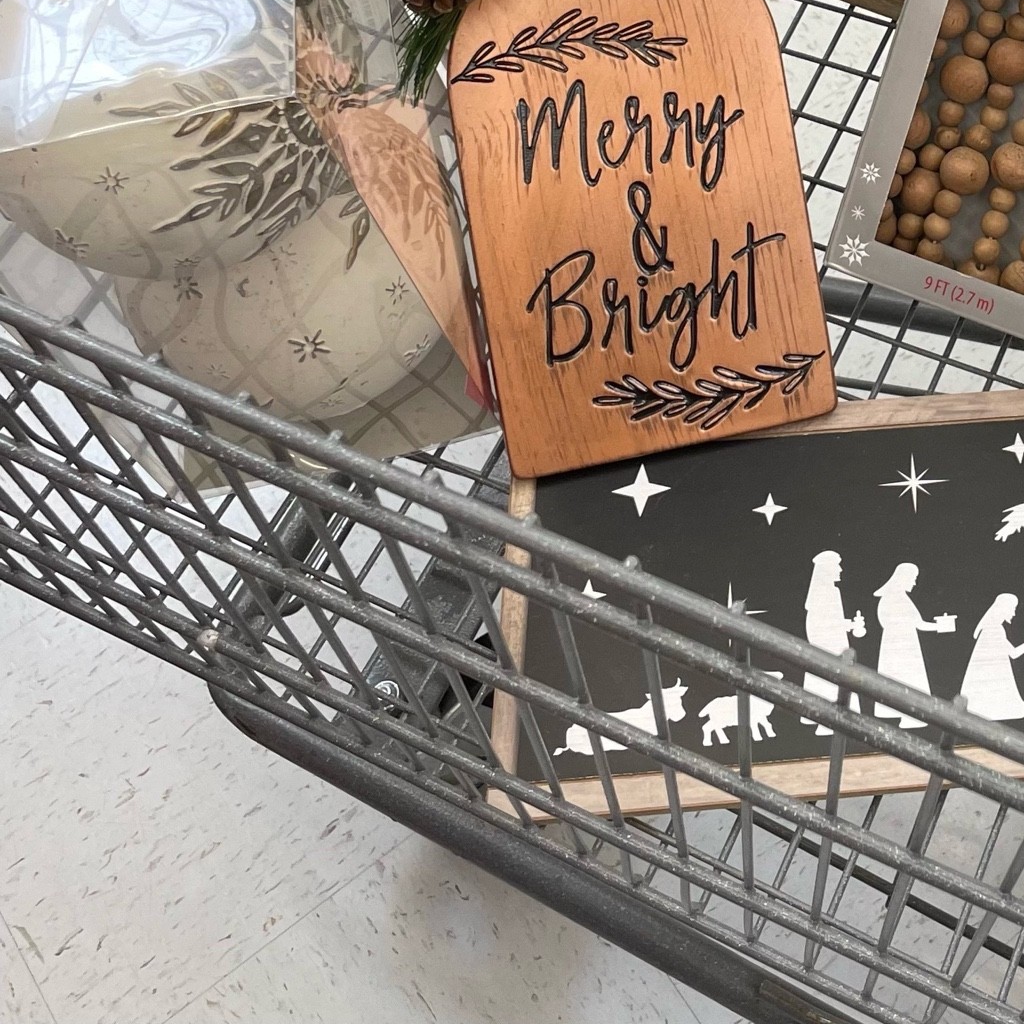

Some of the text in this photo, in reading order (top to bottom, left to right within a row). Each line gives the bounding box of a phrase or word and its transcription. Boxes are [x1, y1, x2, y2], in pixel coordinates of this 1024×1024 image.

[516, 79, 744, 192] Merry
[627, 180, 675, 276] &
[526, 222, 786, 373] Bright
[924, 276, 995, 315] 9 FT (2.7 m)
